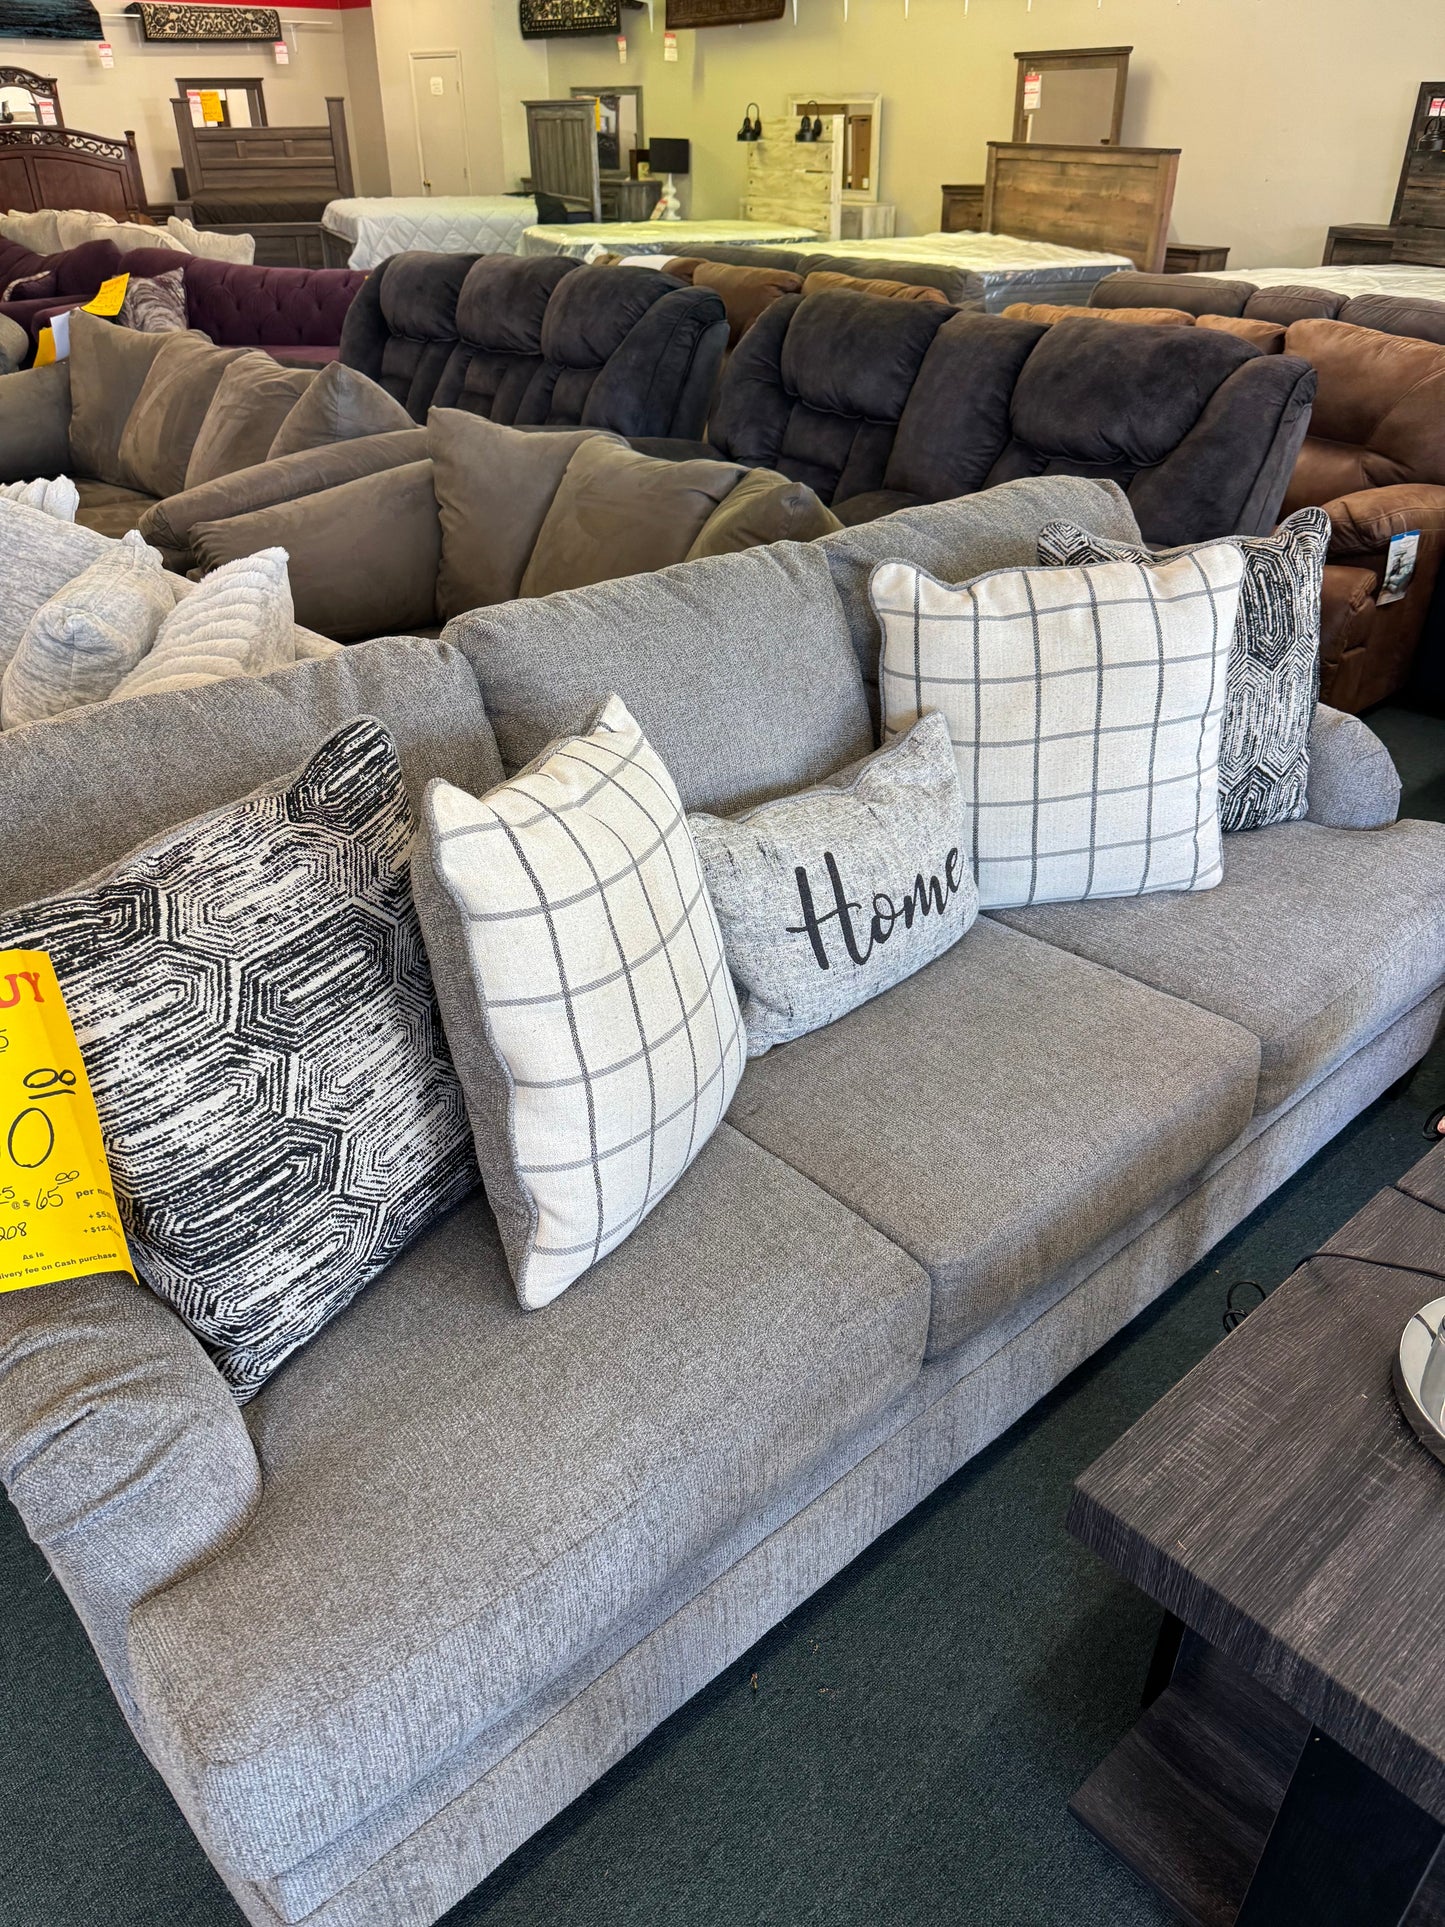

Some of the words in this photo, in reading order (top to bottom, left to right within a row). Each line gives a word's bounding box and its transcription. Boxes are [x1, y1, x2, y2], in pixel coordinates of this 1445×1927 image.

[785, 847, 965, 970] Home
[76, 1188, 94, 1199] per
[54, 1259, 77, 1268] Cash
[79, 1252, 117, 1264] purchase
